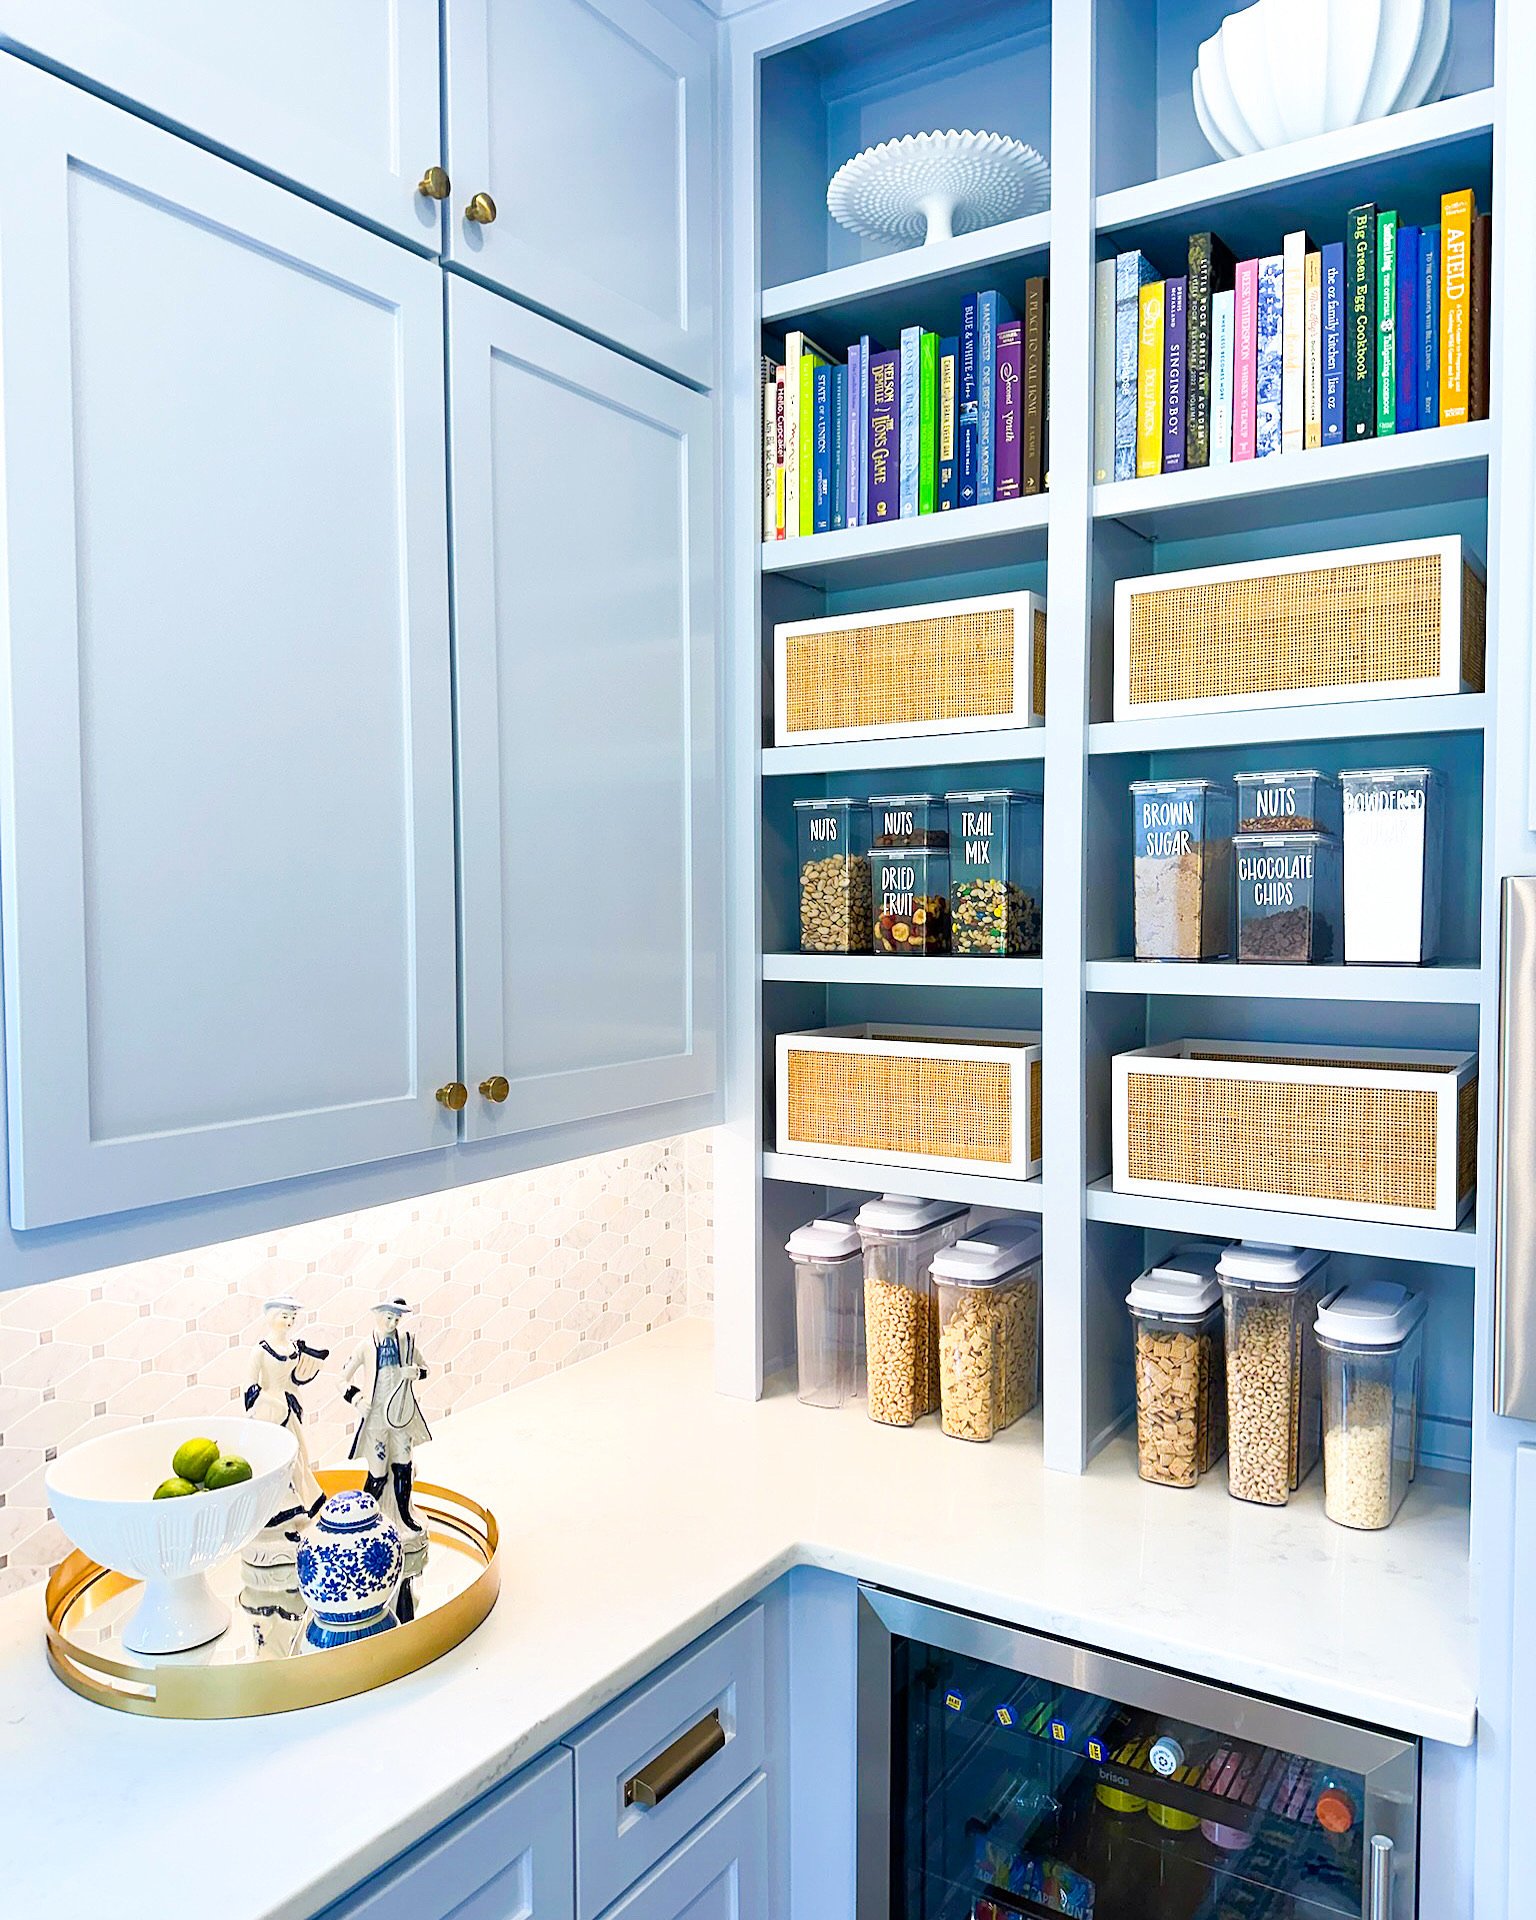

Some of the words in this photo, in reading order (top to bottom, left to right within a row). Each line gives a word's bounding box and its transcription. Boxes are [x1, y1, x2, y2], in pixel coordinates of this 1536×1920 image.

[1355, 215, 1367, 239] Big
[1328, 267, 1338, 284] the
[1357, 242, 1367, 281] Green
[1446, 228, 1466, 300] AFIELD
[1241, 271, 1251, 299] REESE
[1328, 286, 1336, 298] oz
[1355, 285, 1367, 312] Egg
[965, 306, 974, 330] BLUE
[1028, 301, 1038, 333] PLACE
[1325, 301, 1338, 331] family
[981, 303, 991, 362] MANCHESTER
[1028, 337, 1038, 349] TO
[1241, 300, 1251, 361] WITHERSPOON
[965, 340, 973, 372] WHITE
[1327, 333, 1338, 370] kitchen
[1356, 315, 1368, 380] Cookbook
[1382, 334, 1393, 377] Tailgating
[904, 341, 914, 390] COASTAL
[943, 360, 951, 384] CHANGE
[981, 365, 991, 386] ONE
[1028, 353, 1038, 379] CALL
[1121, 342, 1132, 396] Timelapse
[1169, 344, 1180, 404] SINGING
[818, 374, 826, 403] STATE
[871, 365, 884, 405] DEMILLE
[884, 362, 894, 402] NELSON
[1000, 362, 1018, 404] Second
[1328, 377, 1338, 394] lisa
[777, 388, 785, 414] Hello,
[819, 405, 825, 415] OF
[904, 393, 914, 427] BLUES
[981, 387, 991, 409] BRIEF
[1028, 384, 1038, 416] HOME
[1327, 396, 1336, 409] oz
[886, 418, 894, 431] THE
[943, 425, 951, 444] EVERY
[981, 410, 991, 445] SHINING
[1001, 410, 1015, 443] Youth
[1169, 407, 1180, 435] BOY
[1240, 410, 1248, 438] TEACUP
[777, 416, 785, 459] Cupcake!
[818, 422, 826, 454] UNION
[943, 445, 951, 457] DAY
[871, 448, 889, 485] GAME
[981, 446, 991, 484] MOMENT
[766, 478, 774, 498] Cook
[1143, 800, 1194, 829] BROWN
[1256, 788, 1296, 817] NUTS
[1343, 788, 1426, 813] POWDERED
[810, 818, 837, 841] NUTS
[884, 812, 913, 836] NUTS
[962, 812, 994, 837] TRAIL
[965, 840, 990, 864] MIX
[1146, 830, 1192, 857] SUGAR
[882, 866, 914, 891] DRIED
[1238, 854, 1313, 882] CHOCOLATE
[883, 893, 914, 917] FRUIT
[1254, 882, 1293, 906] CHIPS
[1098, 1766, 1130, 1786] brisas
